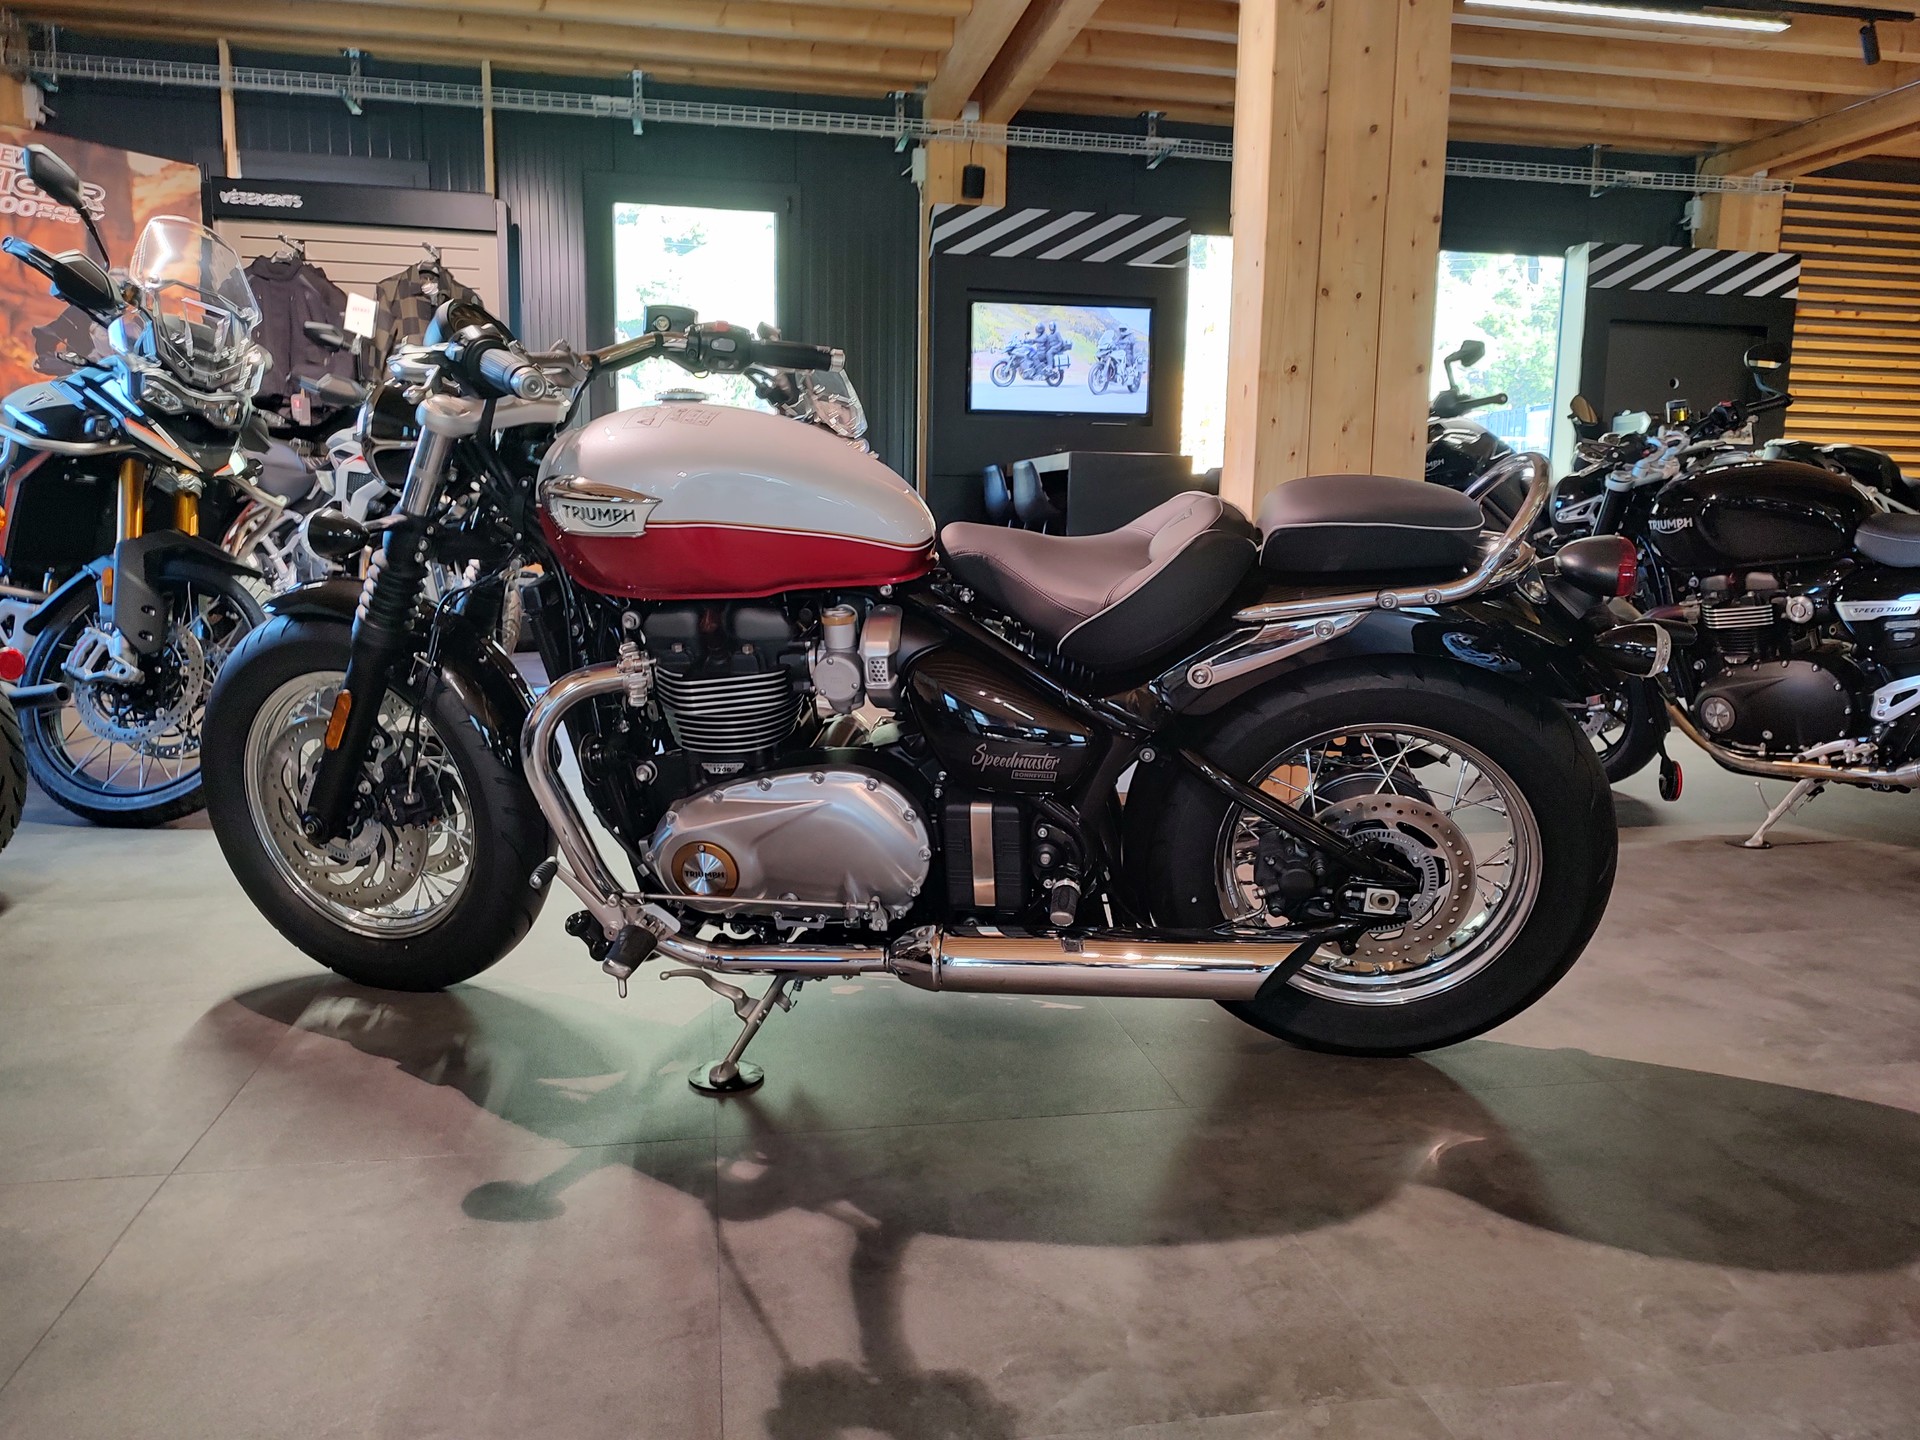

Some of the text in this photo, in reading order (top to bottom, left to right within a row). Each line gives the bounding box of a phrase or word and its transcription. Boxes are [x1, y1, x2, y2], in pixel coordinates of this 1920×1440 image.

[561, 504, 637, 526] TRIUMPH
[1648, 517, 1693, 532] TRIUMPH
[971, 743, 1061, 772] Speedmaster
[1014, 771, 1054, 779] BONNEVILLE
[684, 870, 725, 879] TRIUMPH
